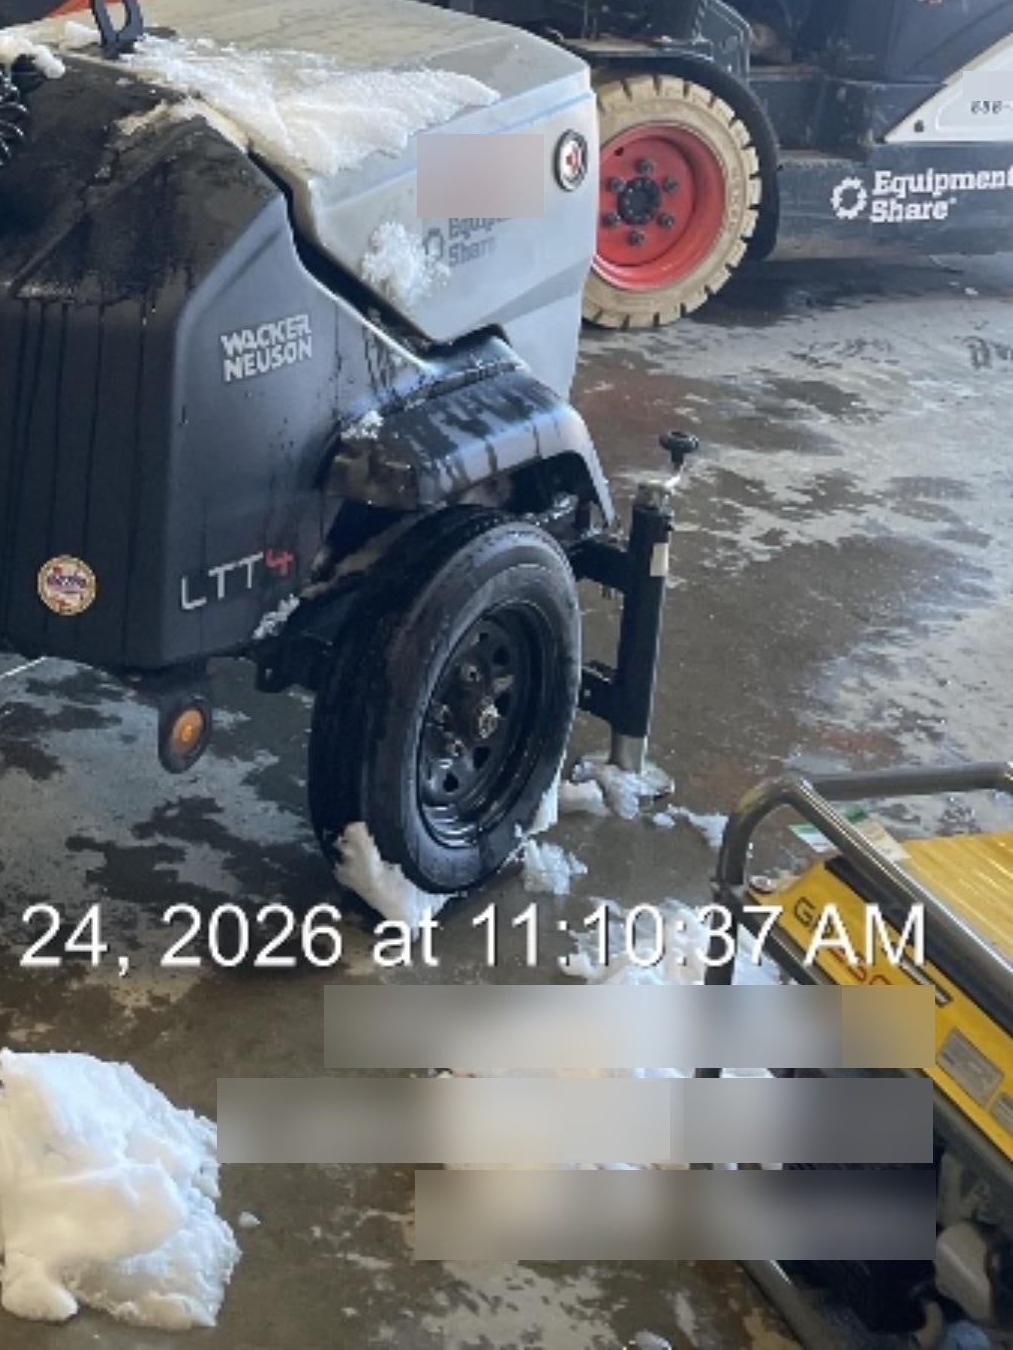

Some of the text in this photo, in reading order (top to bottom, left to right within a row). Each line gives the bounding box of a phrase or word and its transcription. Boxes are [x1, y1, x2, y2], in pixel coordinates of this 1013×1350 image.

[870, 197, 949, 223] Share
[220, 313, 312, 358] WACKER
[223, 335, 312, 382] NEUSON
